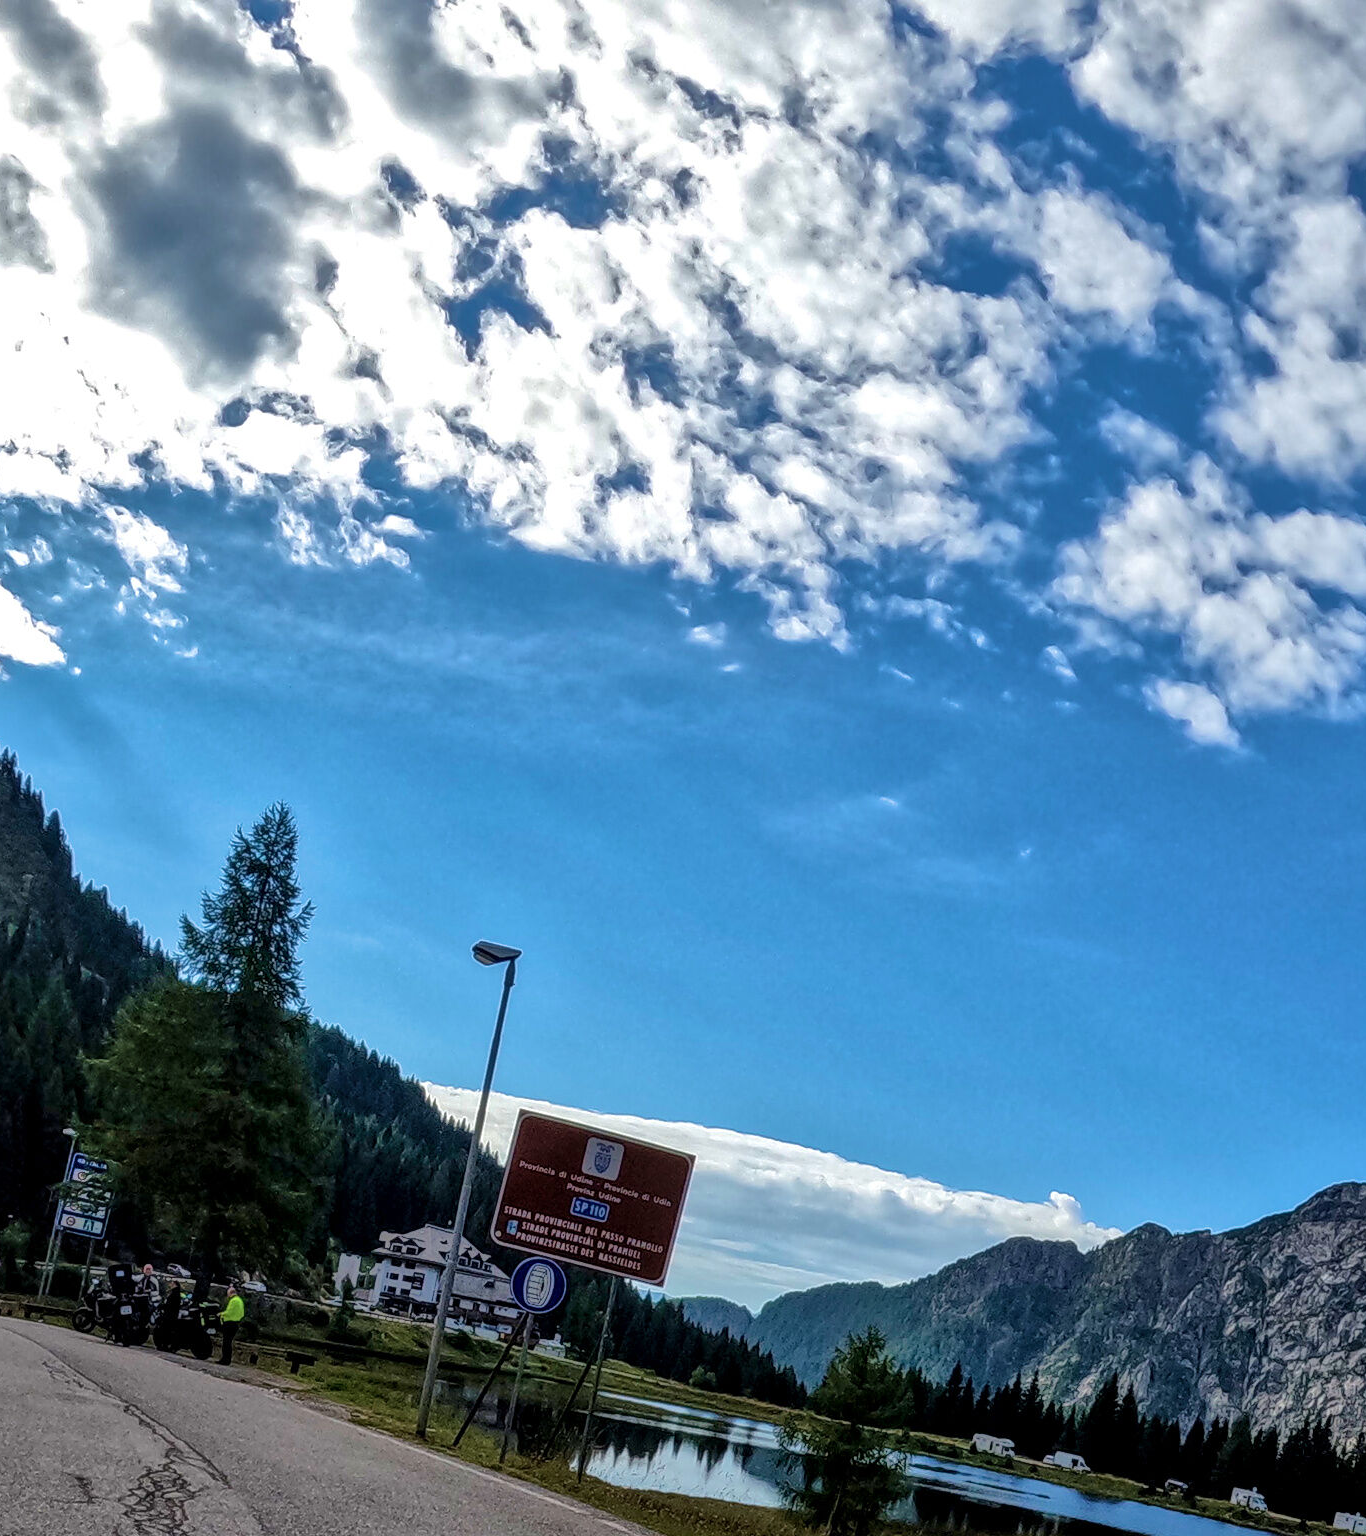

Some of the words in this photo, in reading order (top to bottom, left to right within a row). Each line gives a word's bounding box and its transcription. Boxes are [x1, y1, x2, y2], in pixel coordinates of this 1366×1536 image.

[519, 1160, 555, 1175] Provincia
[559, 1171, 567, 1179] di
[570, 1174, 594, 1186] Udine
[566, 1183, 595, 1197] Provinz
[598, 1191, 621, 1203] Udine
[574, 1200, 588, 1212] SP
[590, 1204, 606, 1218] 110
[504, 1206, 531, 1219] STRADA
[535, 1213, 582, 1232] PROVINCIALE
[585, 1226, 598, 1236] DEL
[601, 1230, 624, 1243] PASSO
[627, 1237, 663, 1253] PRAMOLLO
[522, 1221, 549, 1235] STRADE
[597, 1241, 606, 1249] DI
[516, 1232, 578, 1254] PROVINZSTRASSE
[580, 1248, 594, 1258] DES
